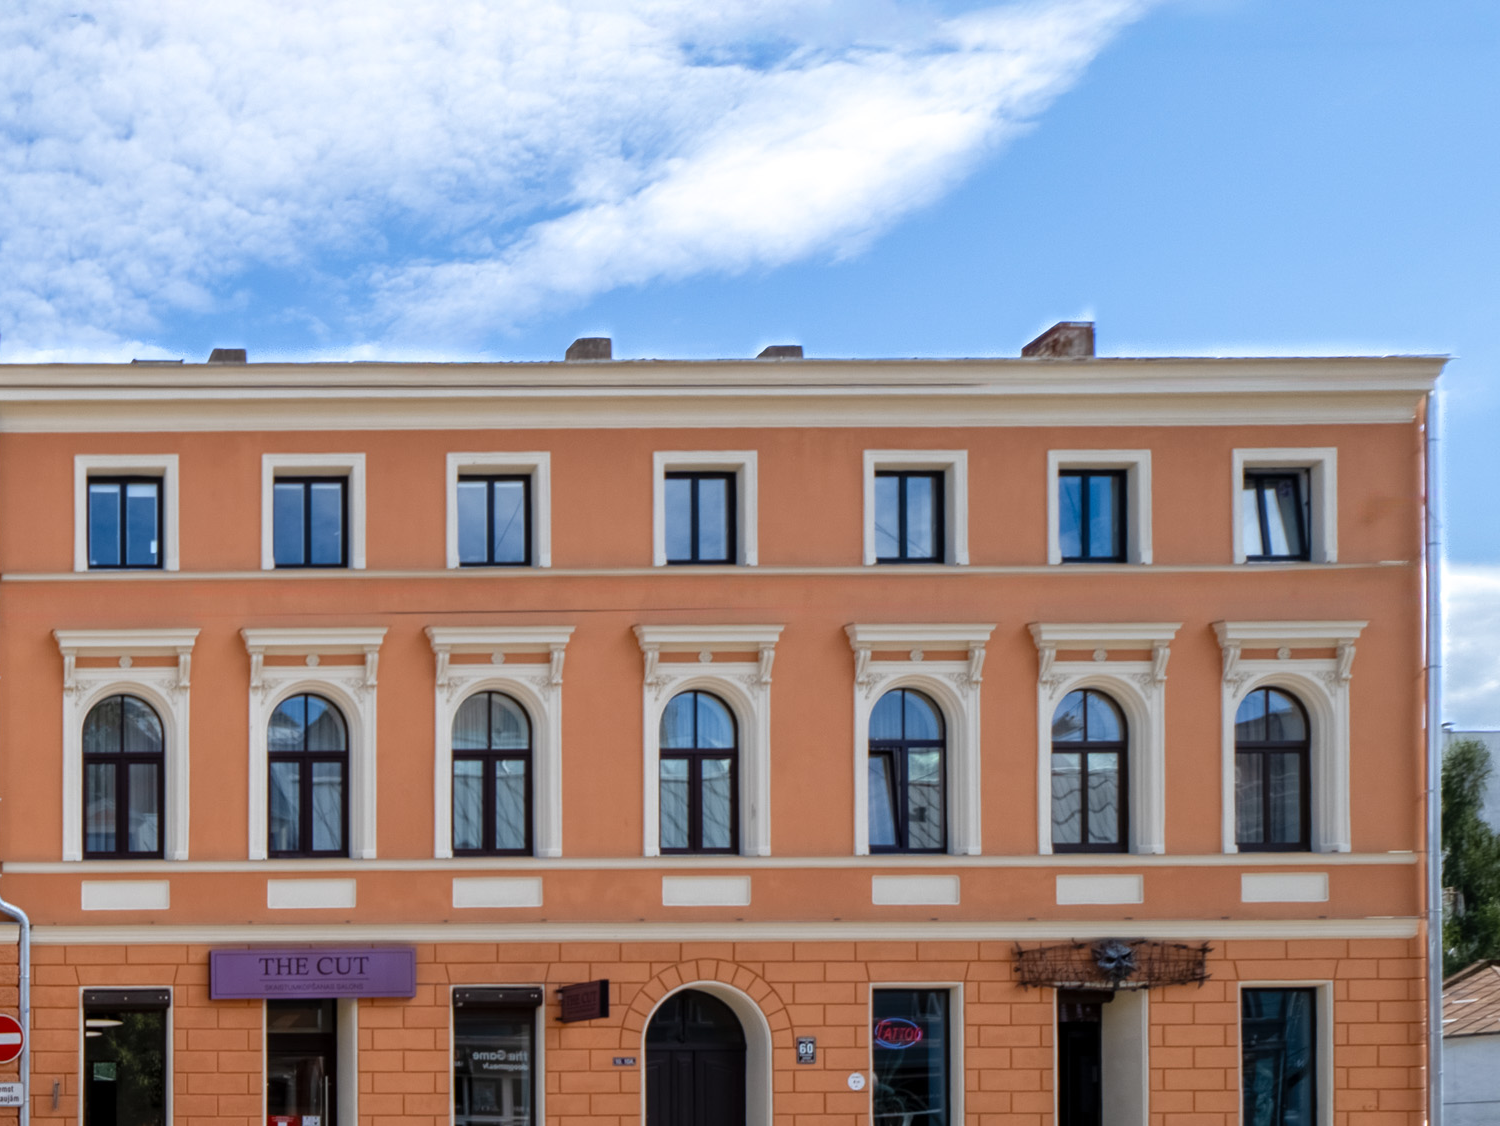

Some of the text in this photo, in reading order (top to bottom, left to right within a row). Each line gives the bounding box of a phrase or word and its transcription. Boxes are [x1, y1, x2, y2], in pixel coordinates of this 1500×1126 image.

[259, 956, 370, 976] THE CUT
[336, 982, 364, 991] SALONS
[799, 1043, 814, 1054] 60
